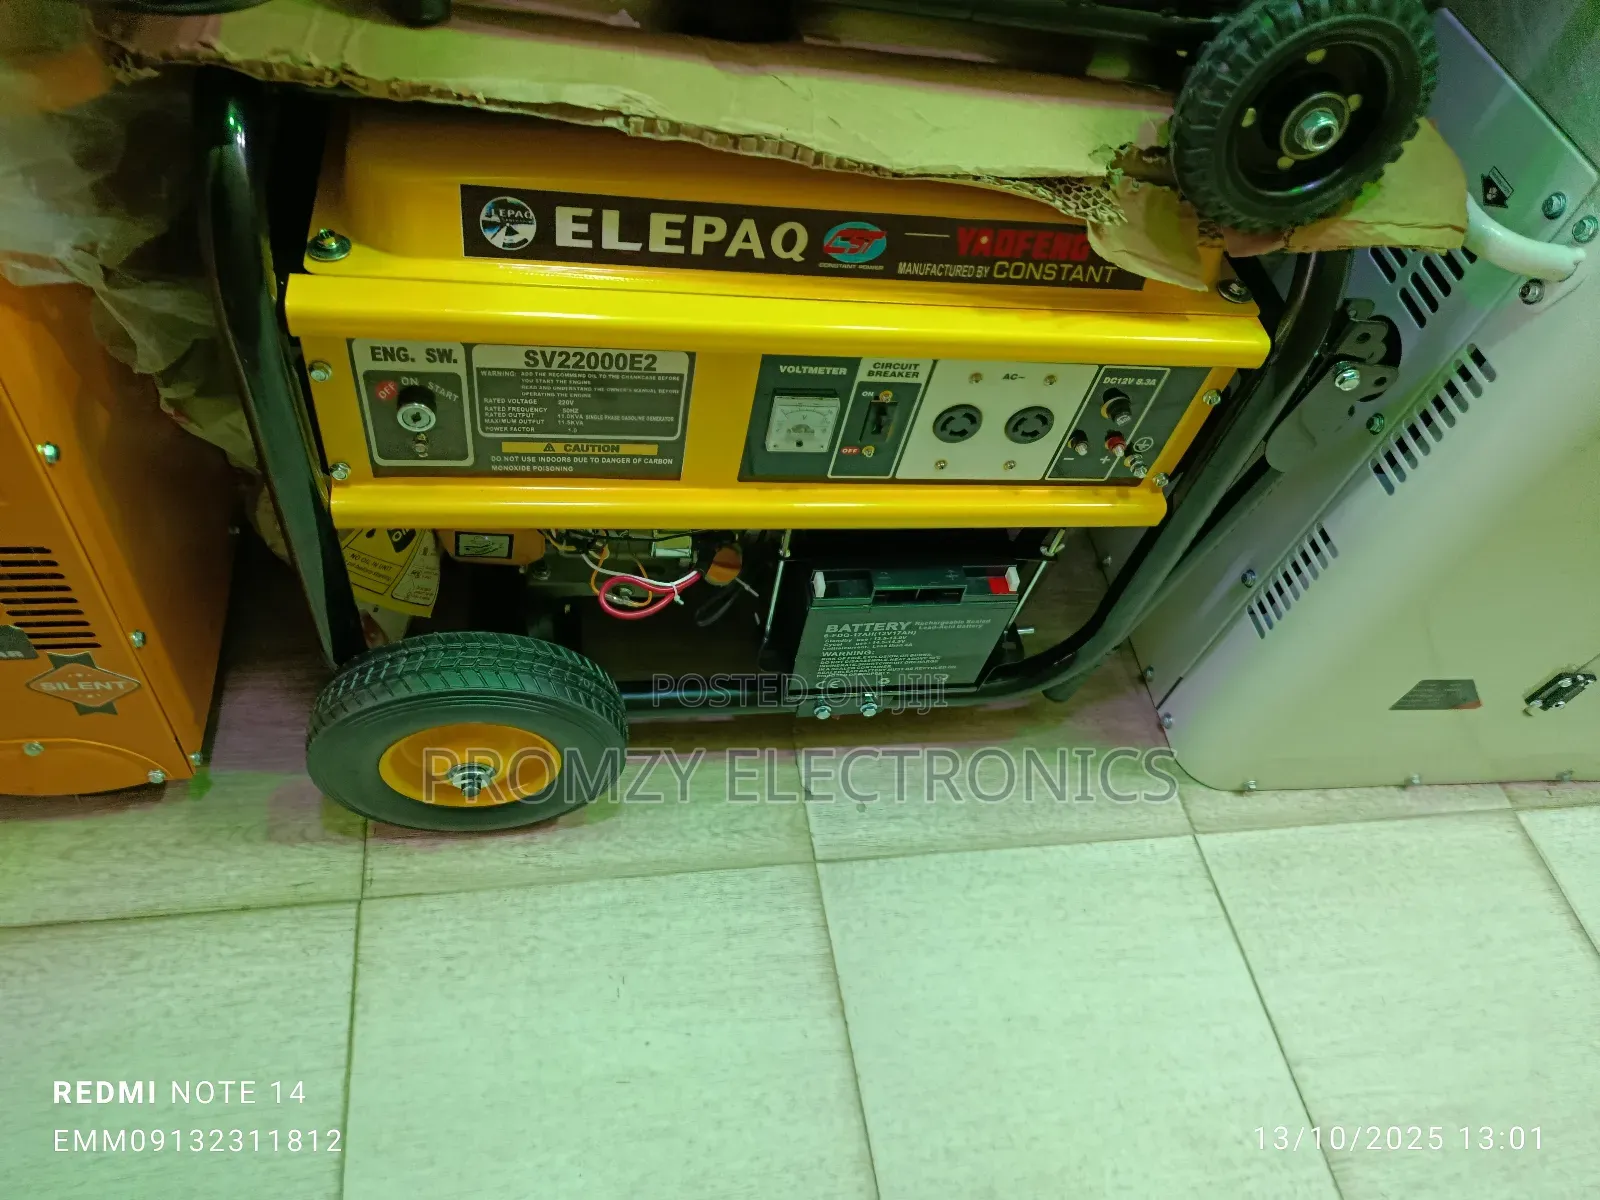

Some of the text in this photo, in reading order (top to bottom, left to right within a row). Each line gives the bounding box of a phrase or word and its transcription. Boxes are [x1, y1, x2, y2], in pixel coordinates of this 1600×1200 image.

[555, 206, 809, 262] ELEPAQ
[898, 261, 1117, 284] MANUFACTURED BY CONSTANT
[370, 346, 458, 364] ENG. SW.
[524, 350, 658, 372] SV22000E2
[872, 362, 920, 370] CIRCUIT
[779, 365, 848, 375] VOLTMETER
[867, 370, 920, 378] BREAKER
[401, 376, 420, 386] ON
[1103, 377, 1134, 385] DC12V
[378, 381, 397, 400] OFF
[427, 381, 459, 402] START
[564, 444, 620, 453] CAUTION
[826, 622, 912, 633] BATTERY
[40, 681, 128, 691] SILENT
